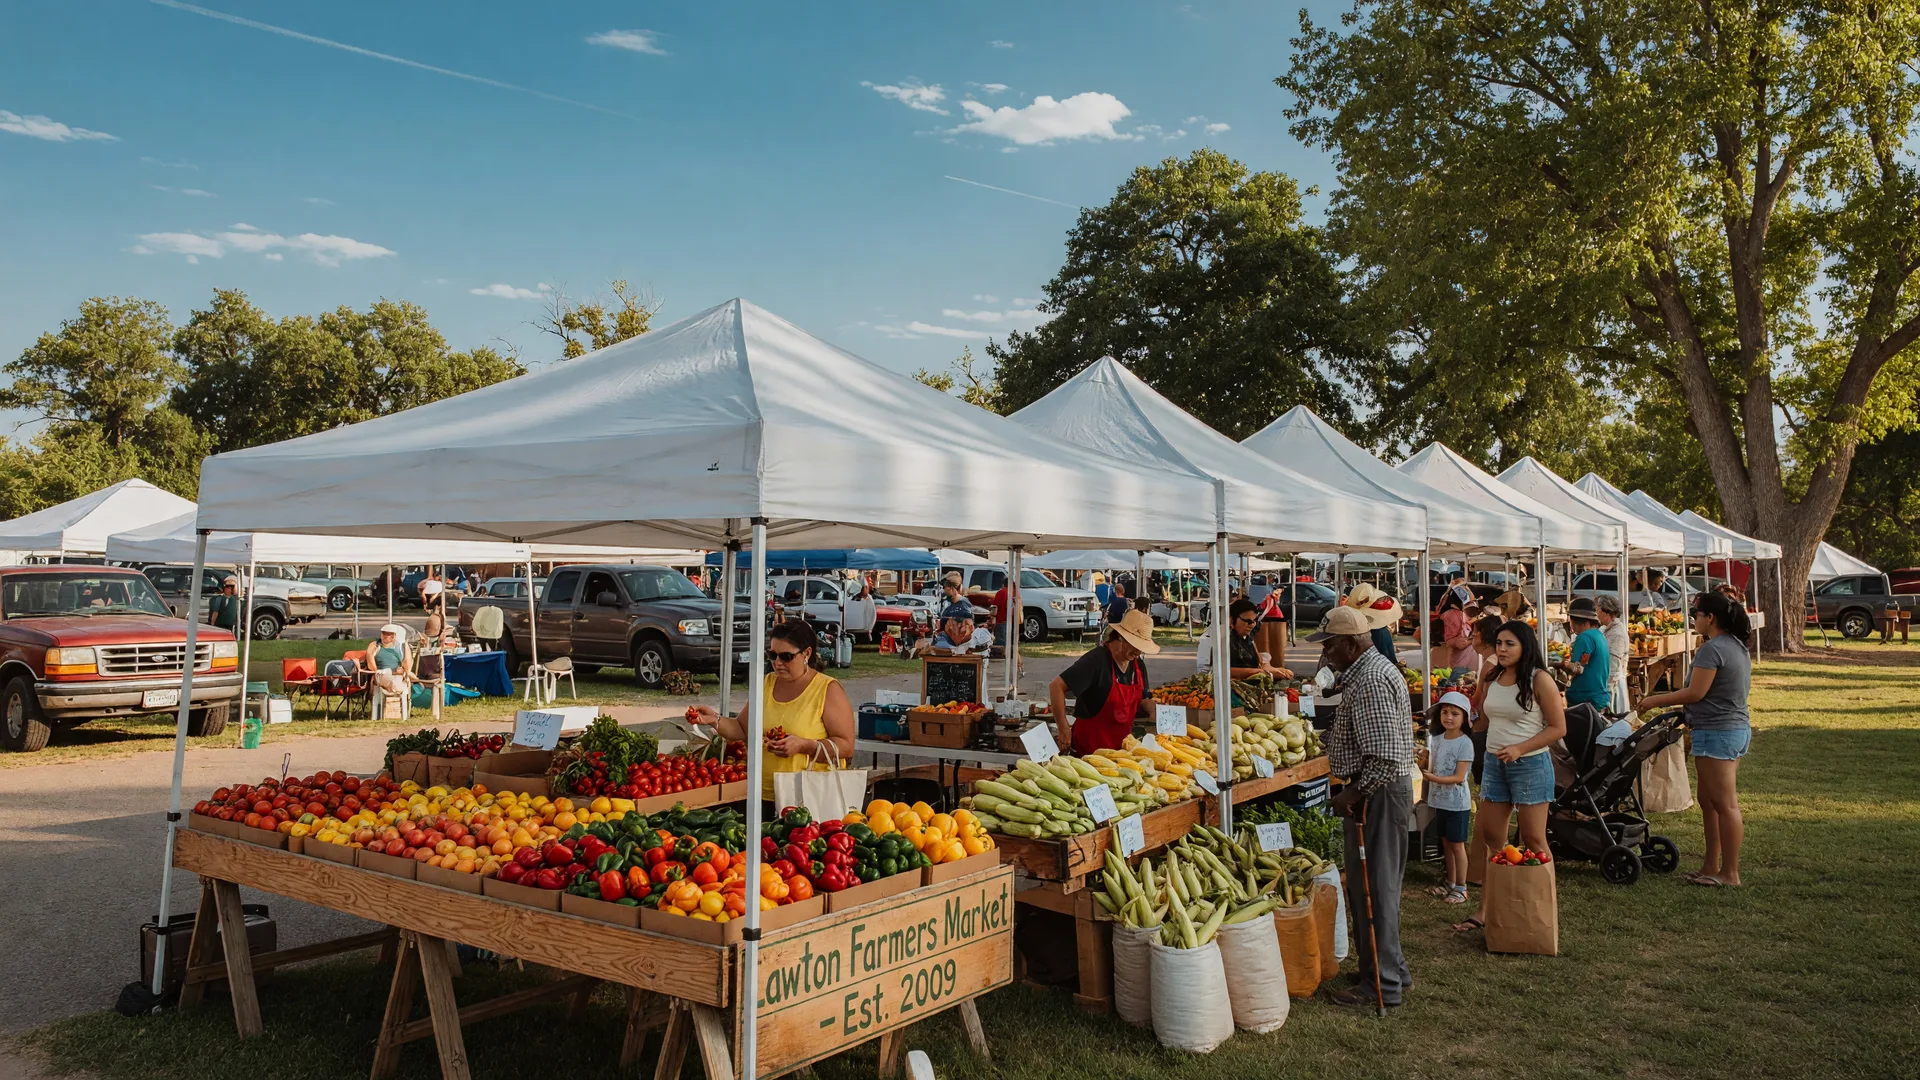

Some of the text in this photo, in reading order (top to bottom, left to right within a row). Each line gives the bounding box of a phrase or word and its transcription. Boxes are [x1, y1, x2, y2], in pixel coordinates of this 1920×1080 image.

[757, 883, 1008, 1008] awton Farmers Market
[900, 958, 957, 1014] 2009
